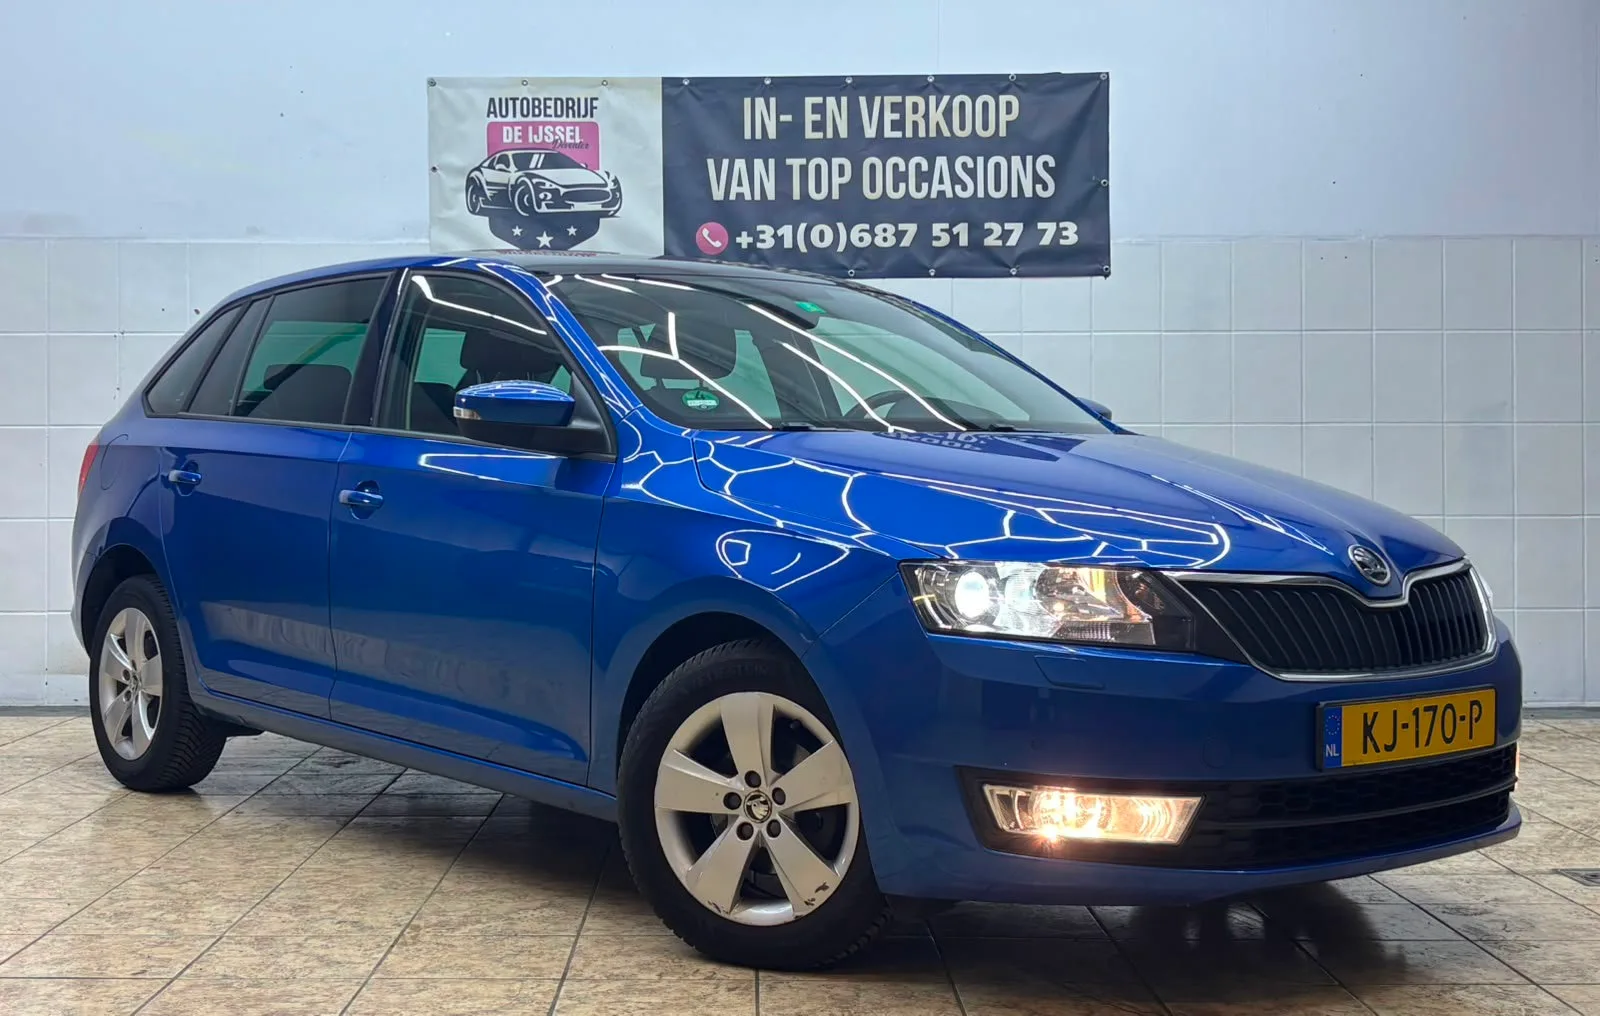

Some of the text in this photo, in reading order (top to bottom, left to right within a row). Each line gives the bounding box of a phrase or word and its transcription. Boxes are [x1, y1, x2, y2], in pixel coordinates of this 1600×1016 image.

[486, 97, 599, 118] AUTOBEDRIJF
[743, 94, 1020, 140] IN- EN VERKOOP
[502, 125, 584, 143] DE IJSSEL
[706, 154, 1056, 201] VAN TOP OCCASIONS
[735, 221, 1079, 253] +31(0)687 51 27 73
[1362, 700, 1483, 755] KJ-170-P
[1325, 743, 1340, 757] NL
